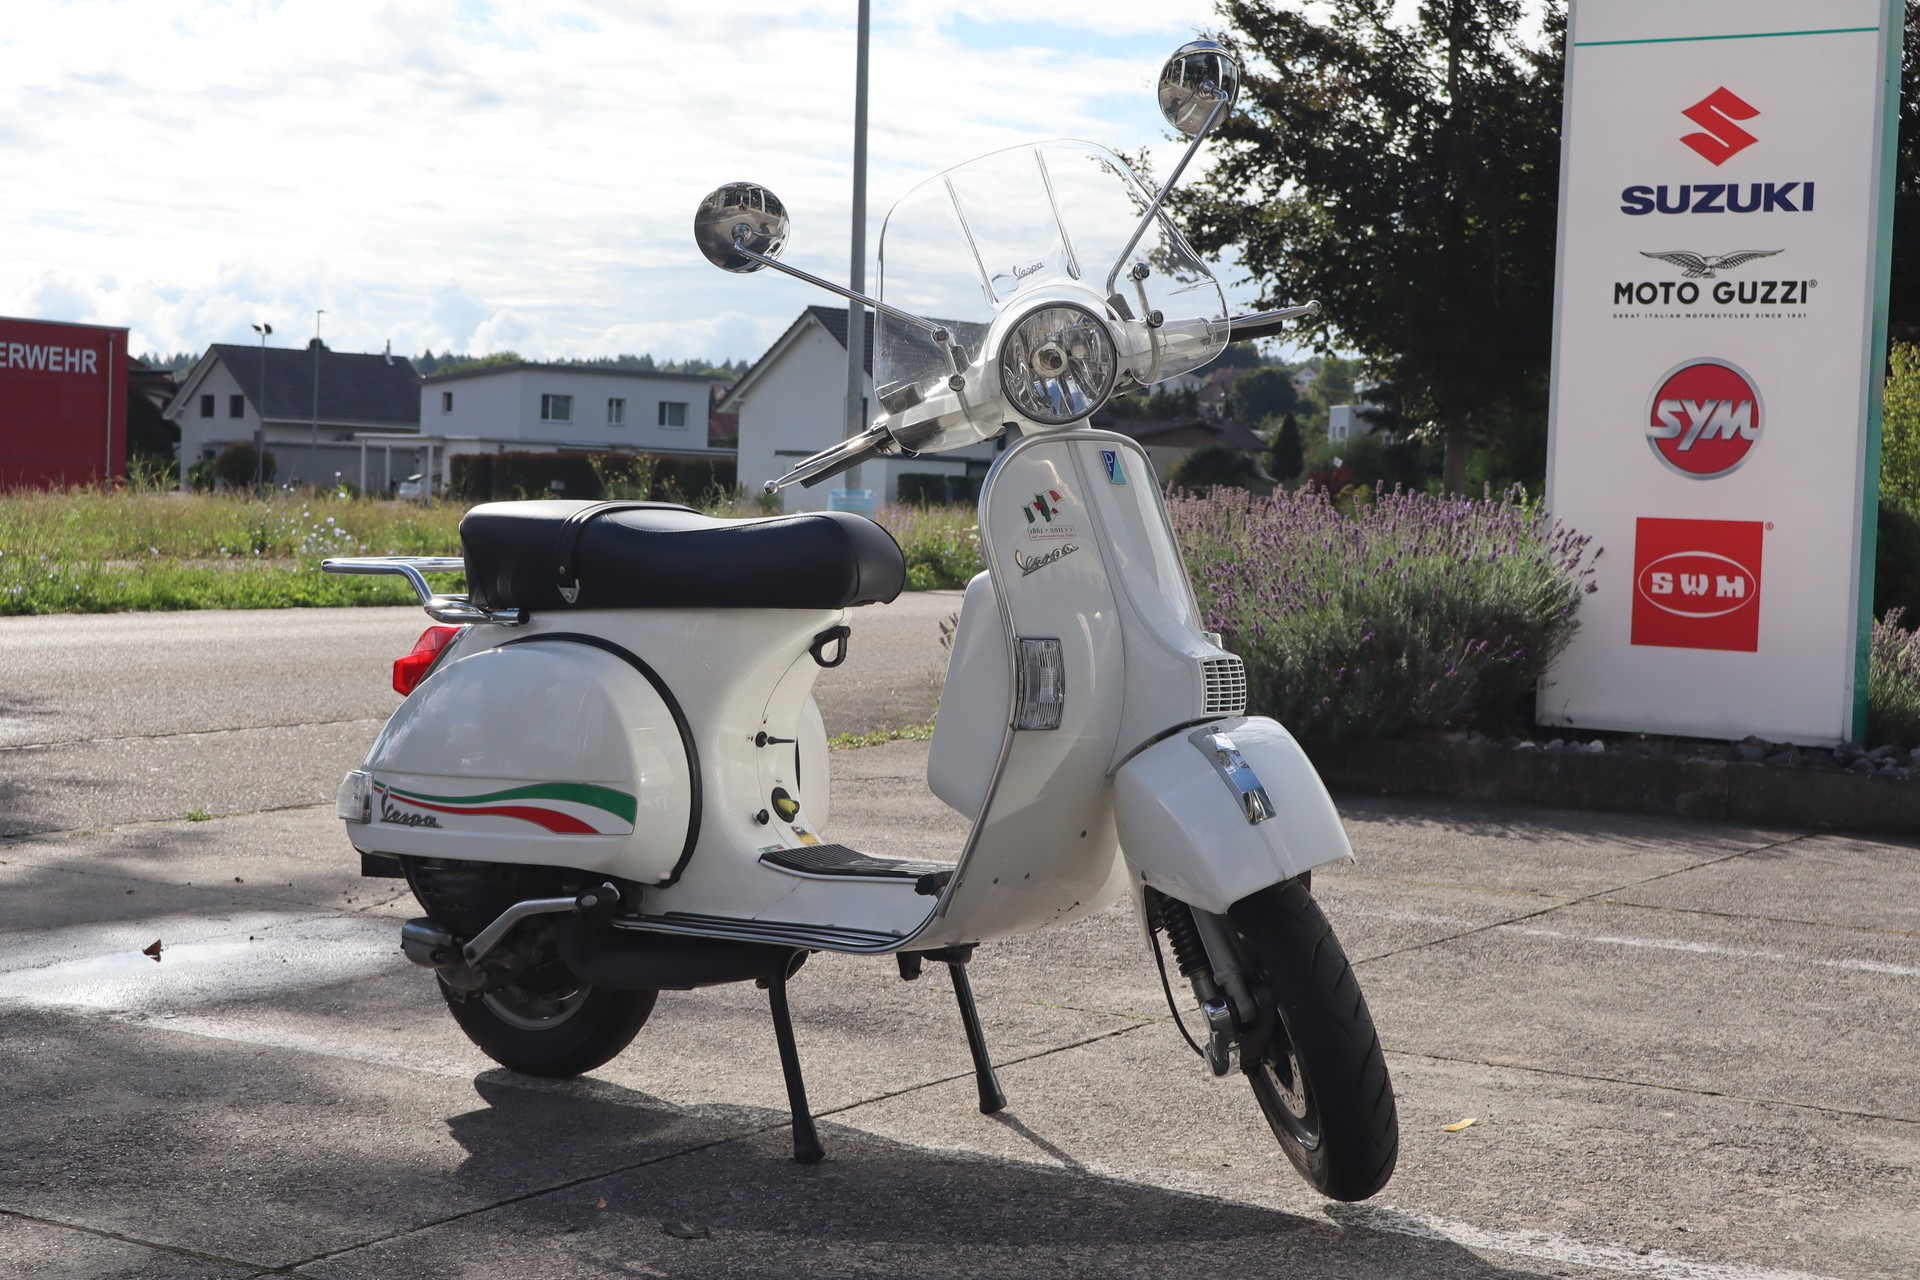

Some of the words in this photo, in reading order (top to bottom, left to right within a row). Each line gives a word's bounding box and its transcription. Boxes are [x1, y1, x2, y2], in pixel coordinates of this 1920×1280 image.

[1620, 181, 1815, 216] SUZUKI
[1012, 262, 1045, 281] Vespa
[1613, 281, 1700, 305] MOTO
[1645, 399, 1758, 450] SYM
[1014, 543, 1079, 577] Vespa
[1651, 572, 1746, 599] SWM
[379, 786, 442, 829] Vespa
